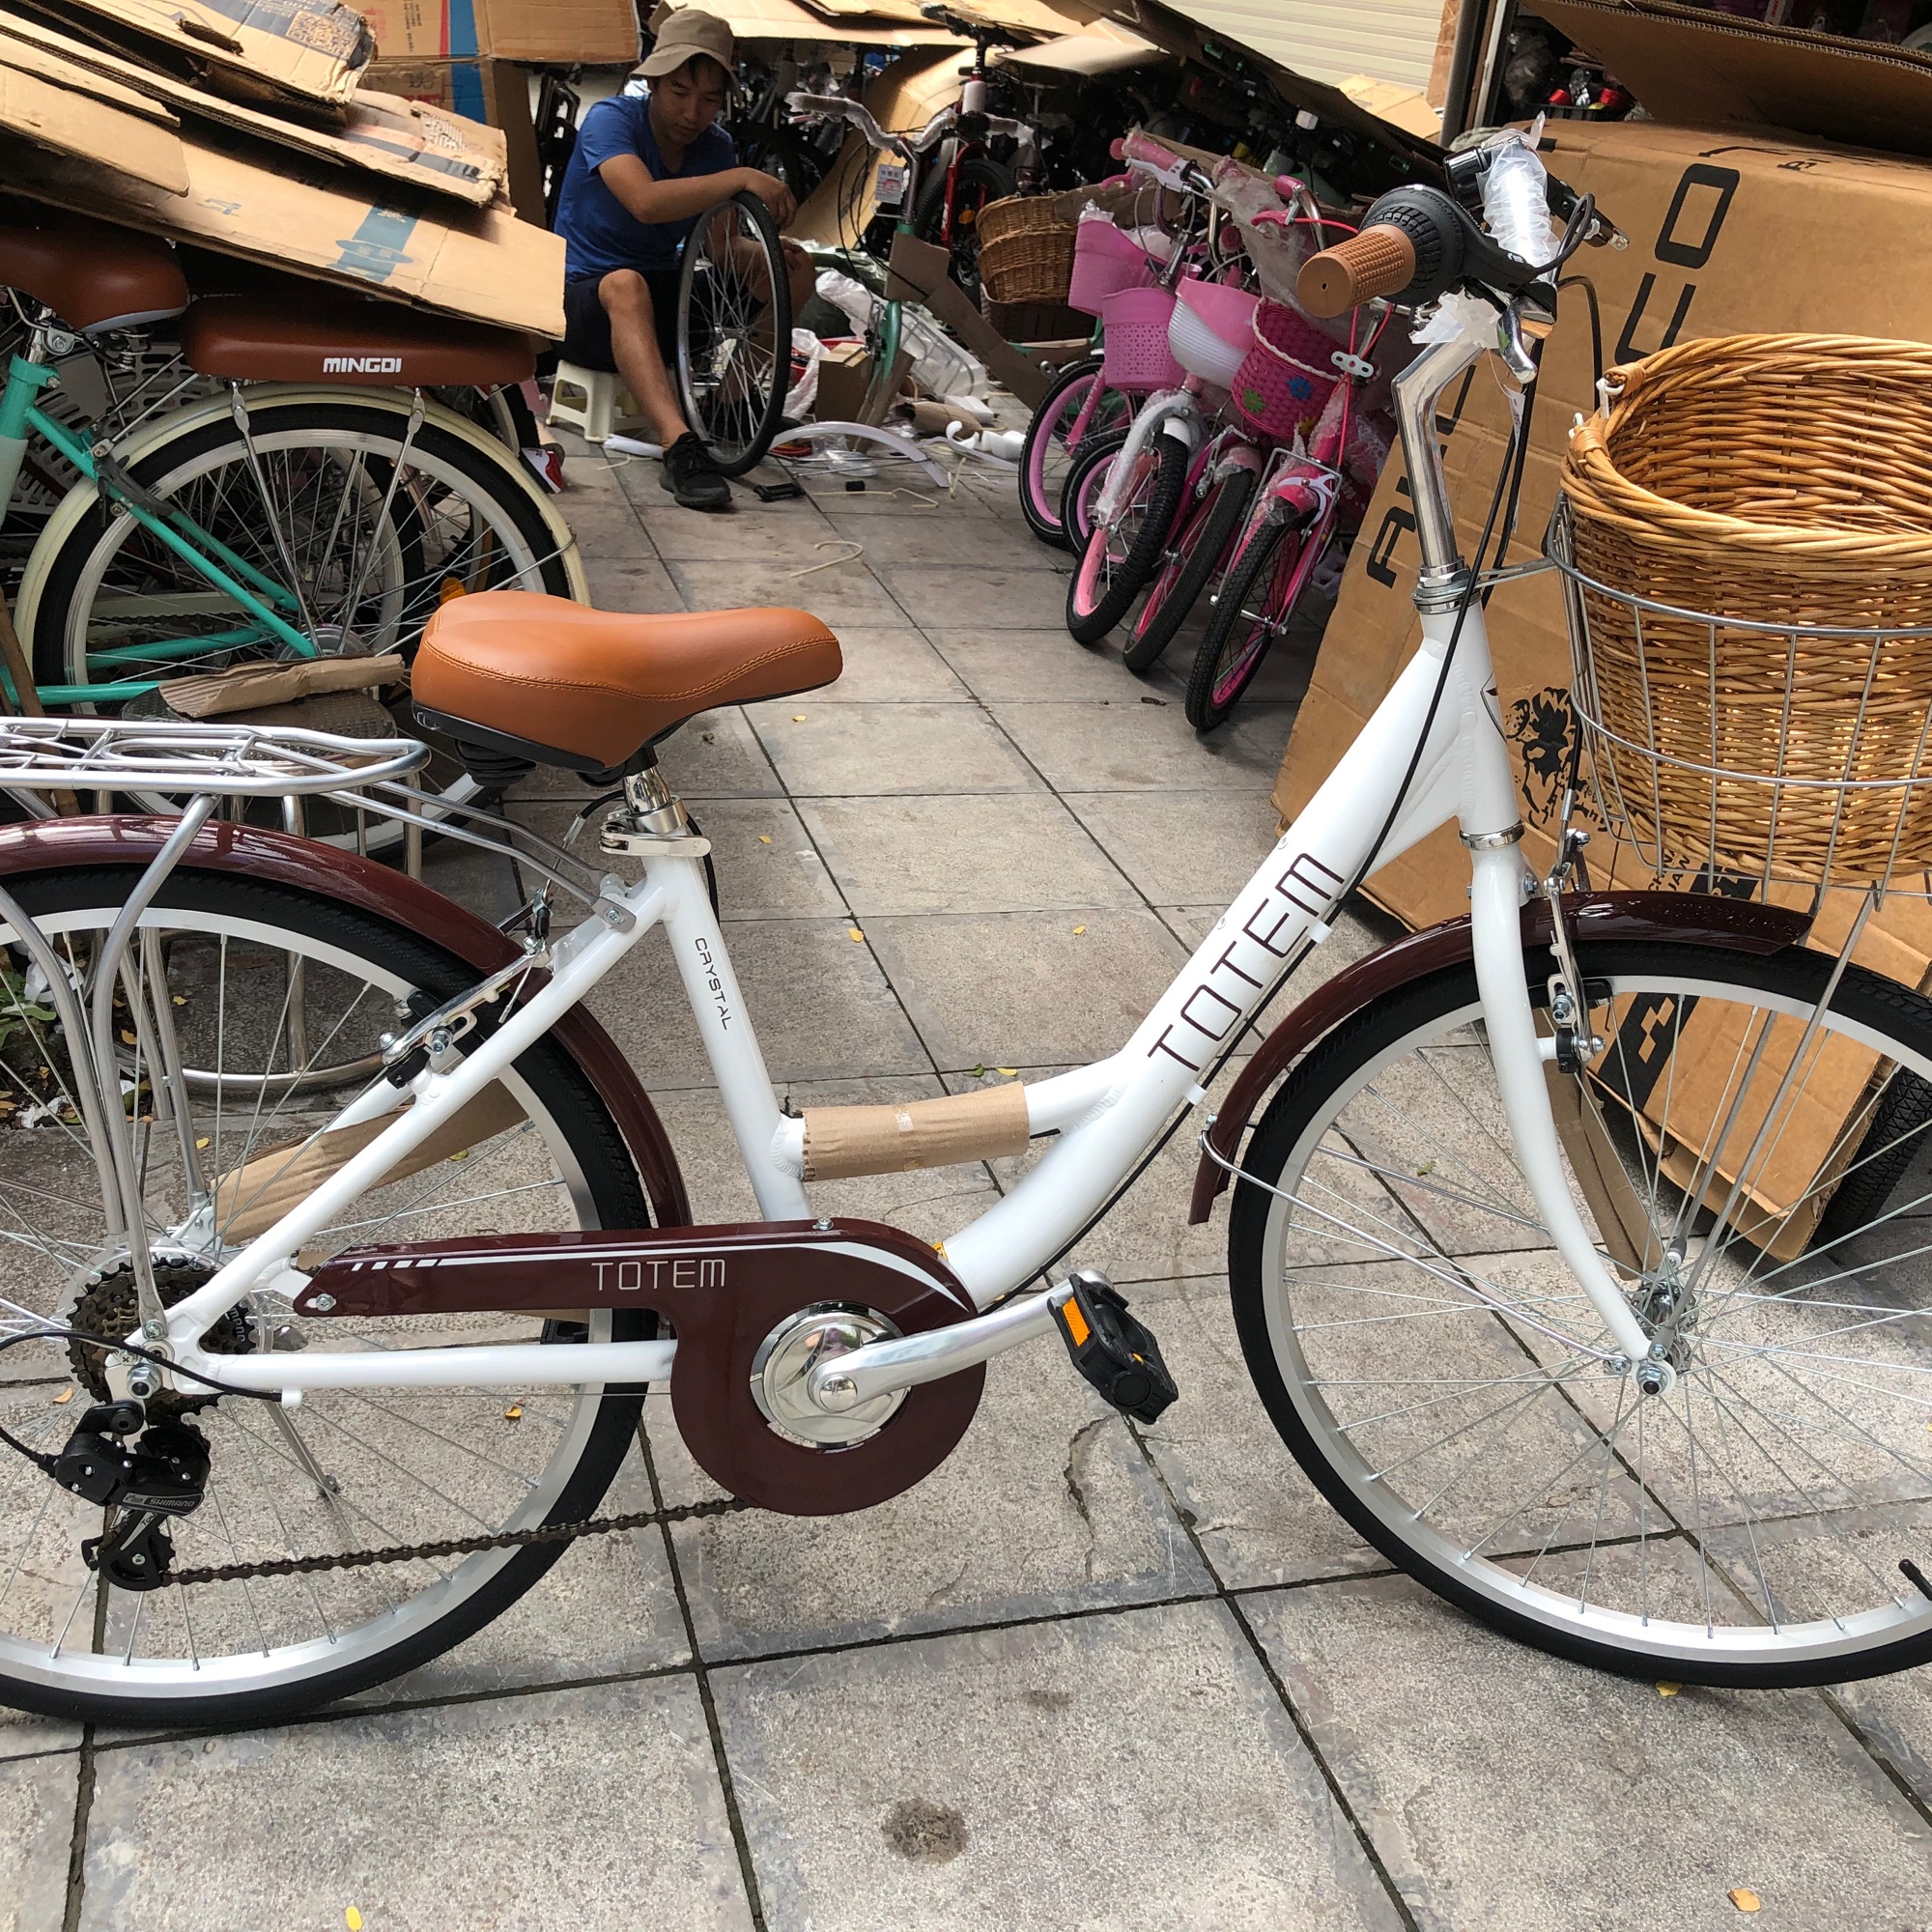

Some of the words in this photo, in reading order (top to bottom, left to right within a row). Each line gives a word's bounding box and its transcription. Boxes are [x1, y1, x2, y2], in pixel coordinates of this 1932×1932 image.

[323, 357, 402, 373] MINGDI
[1147, 853, 1345, 1072] TOTEM
[695, 937, 731, 1031] CRYSTAL
[591, 1259, 725, 1291] TOTEM
[148, 1497, 195, 1507] SHIMANO
